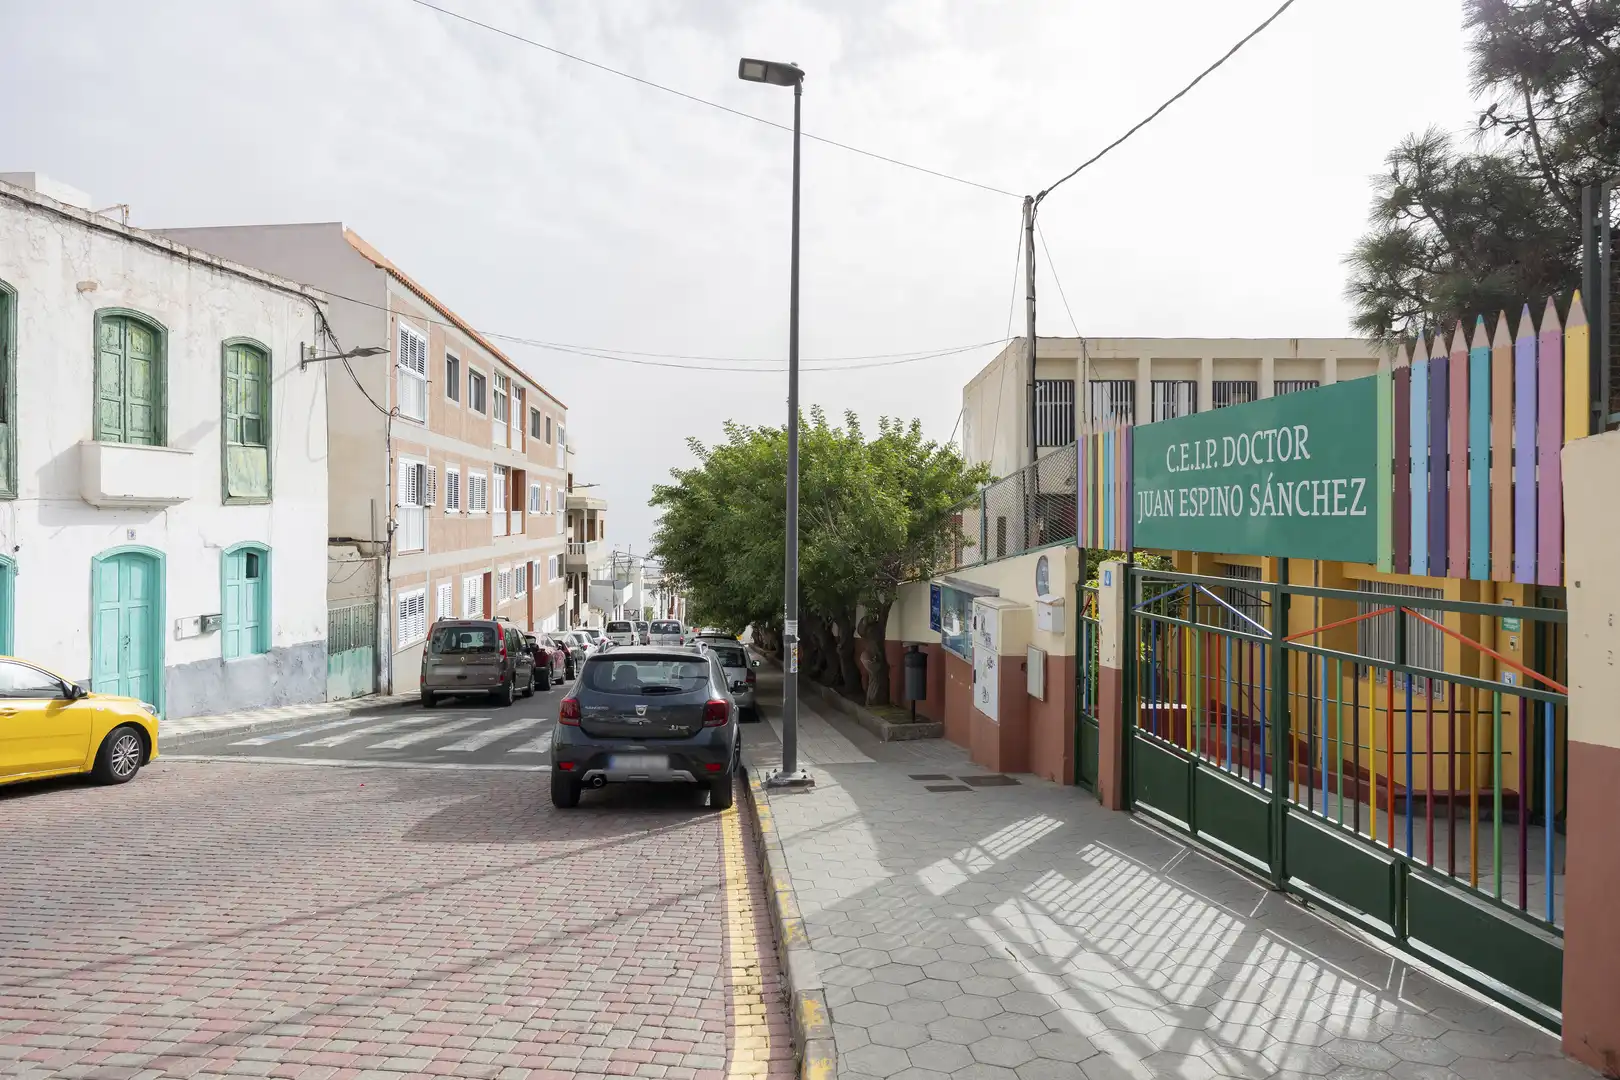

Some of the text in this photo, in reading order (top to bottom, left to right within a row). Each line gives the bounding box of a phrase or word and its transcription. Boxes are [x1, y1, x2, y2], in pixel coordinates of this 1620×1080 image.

[1166, 424, 1311, 473] C.E.I.P. DOCTOR
[1137, 471, 1367, 524] JUAN ESPINO SÁNCHEZ
